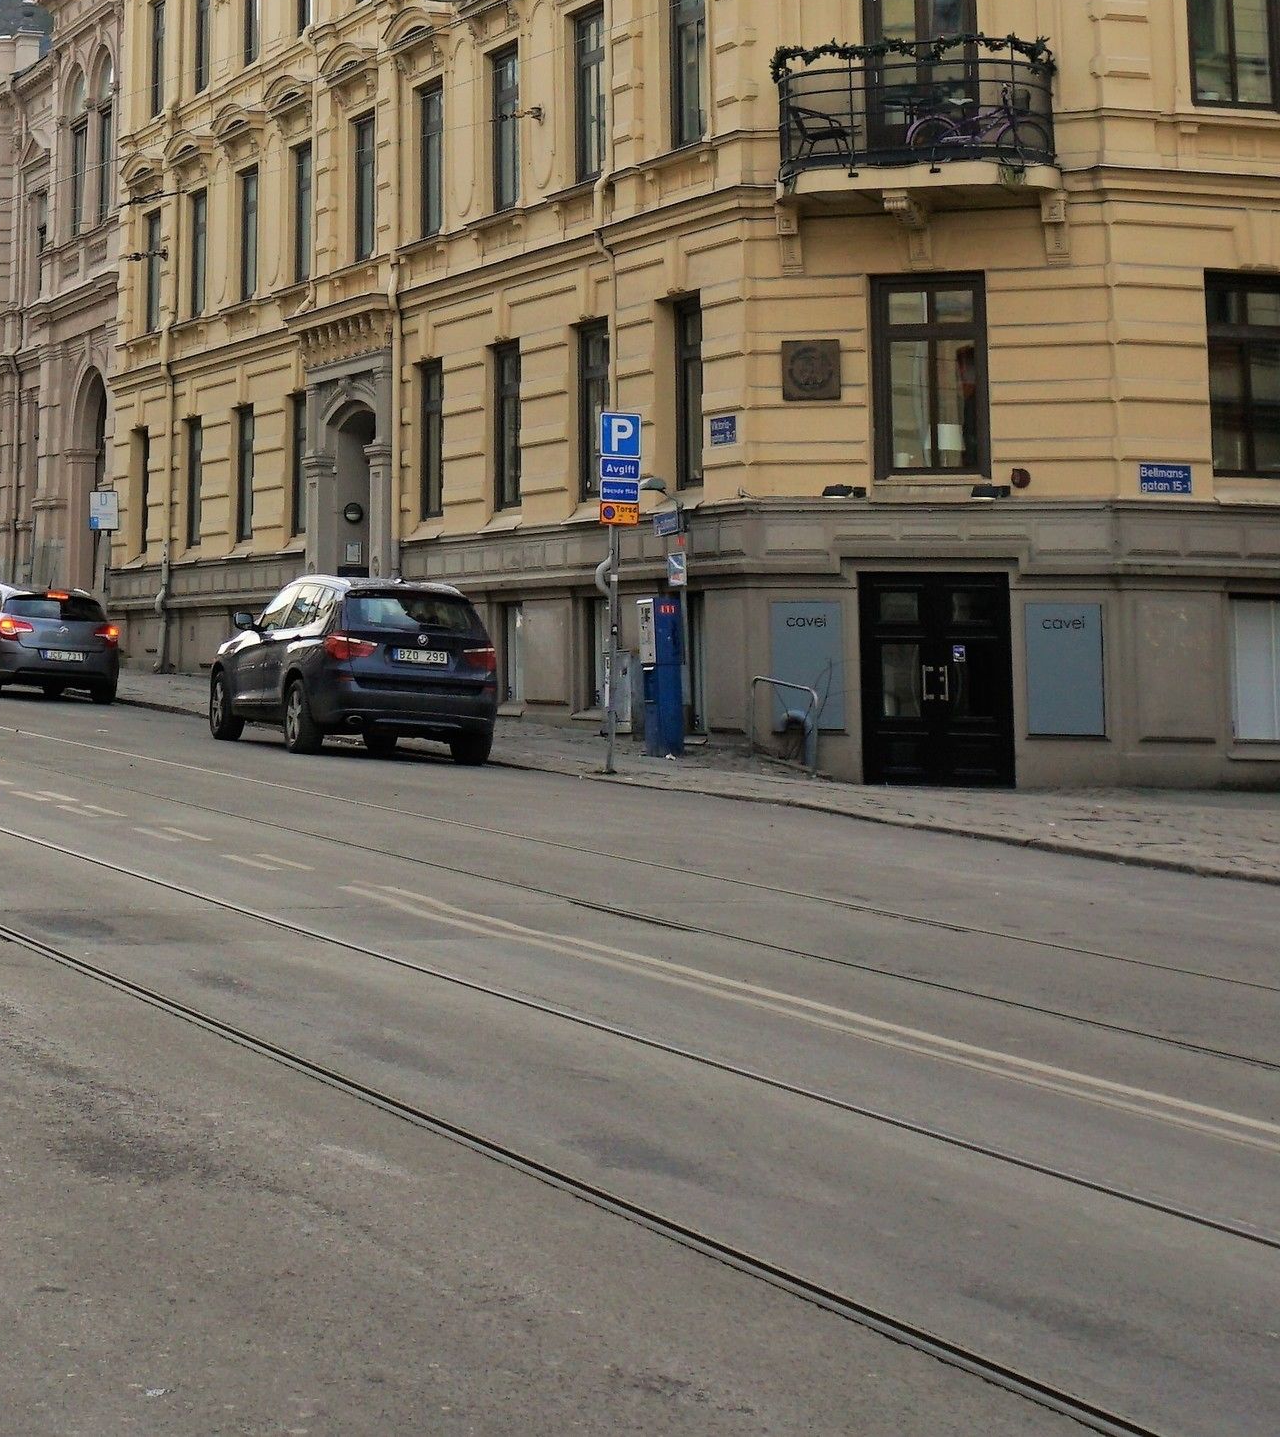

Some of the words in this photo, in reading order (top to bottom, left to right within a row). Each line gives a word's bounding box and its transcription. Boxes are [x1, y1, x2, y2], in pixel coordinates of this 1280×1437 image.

[611, 418, 633, 452] P
[606, 464, 635, 475] Avgift
[1140, 466, 1189, 479] Bellmans-
[1141, 481, 1170, 493] gatan
[786, 614, 827, 628] cavei
[1042, 615, 1085, 630] cavei
[425, 651, 445, 662] 299
